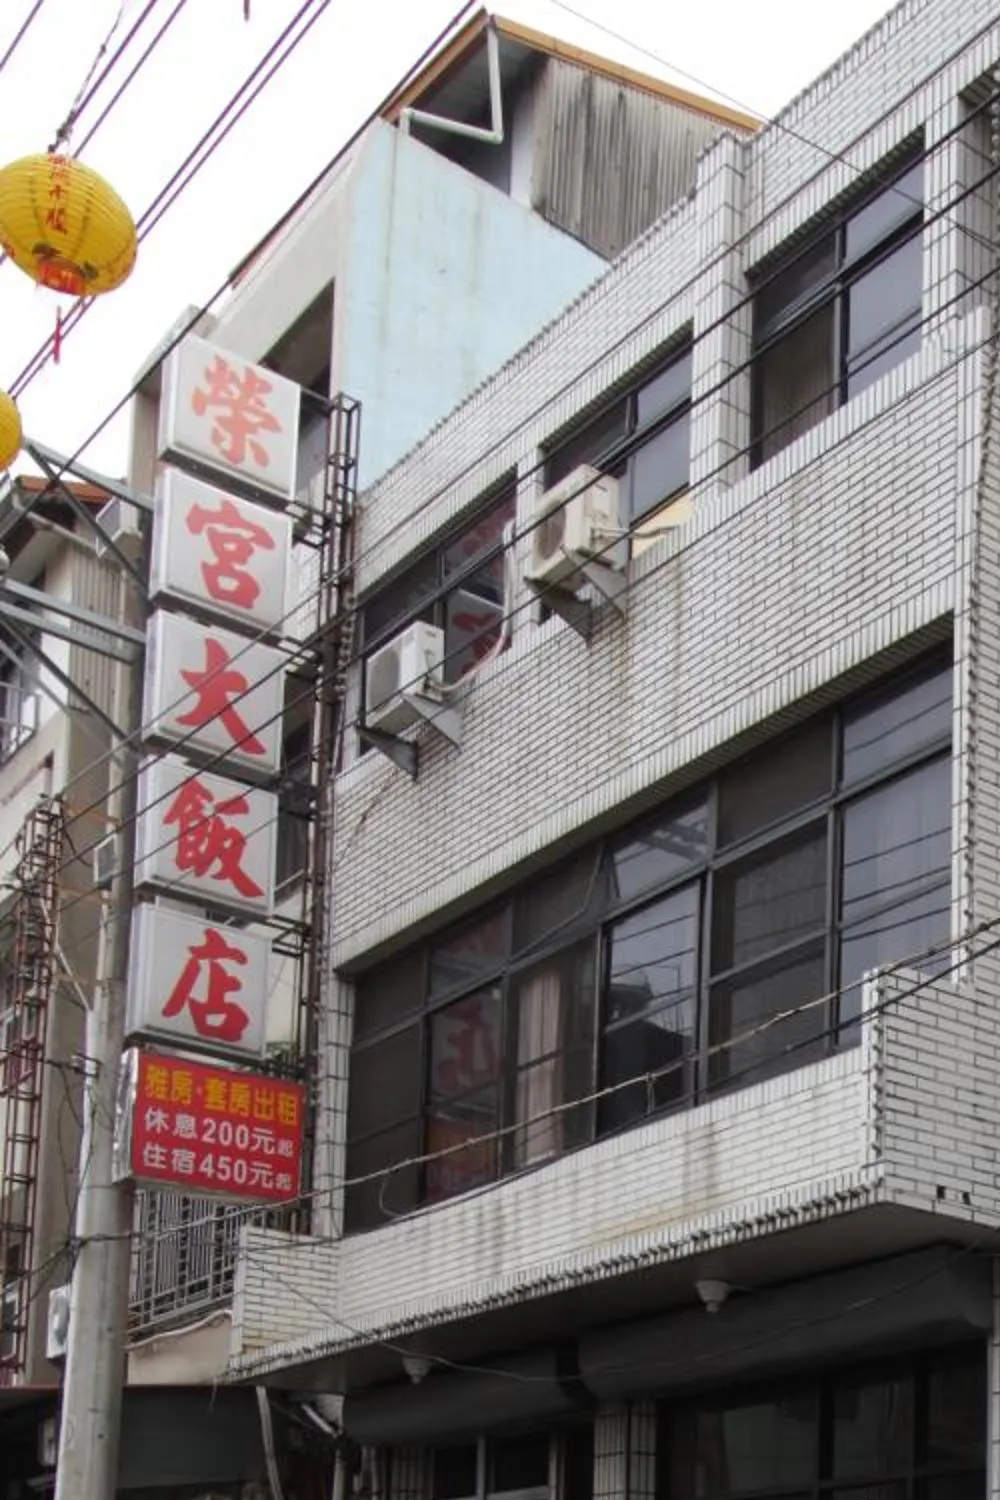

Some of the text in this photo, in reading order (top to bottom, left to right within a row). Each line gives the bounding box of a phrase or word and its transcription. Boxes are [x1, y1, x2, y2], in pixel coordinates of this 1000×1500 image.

[161, 354, 283, 1044] 榮宮大飯店
